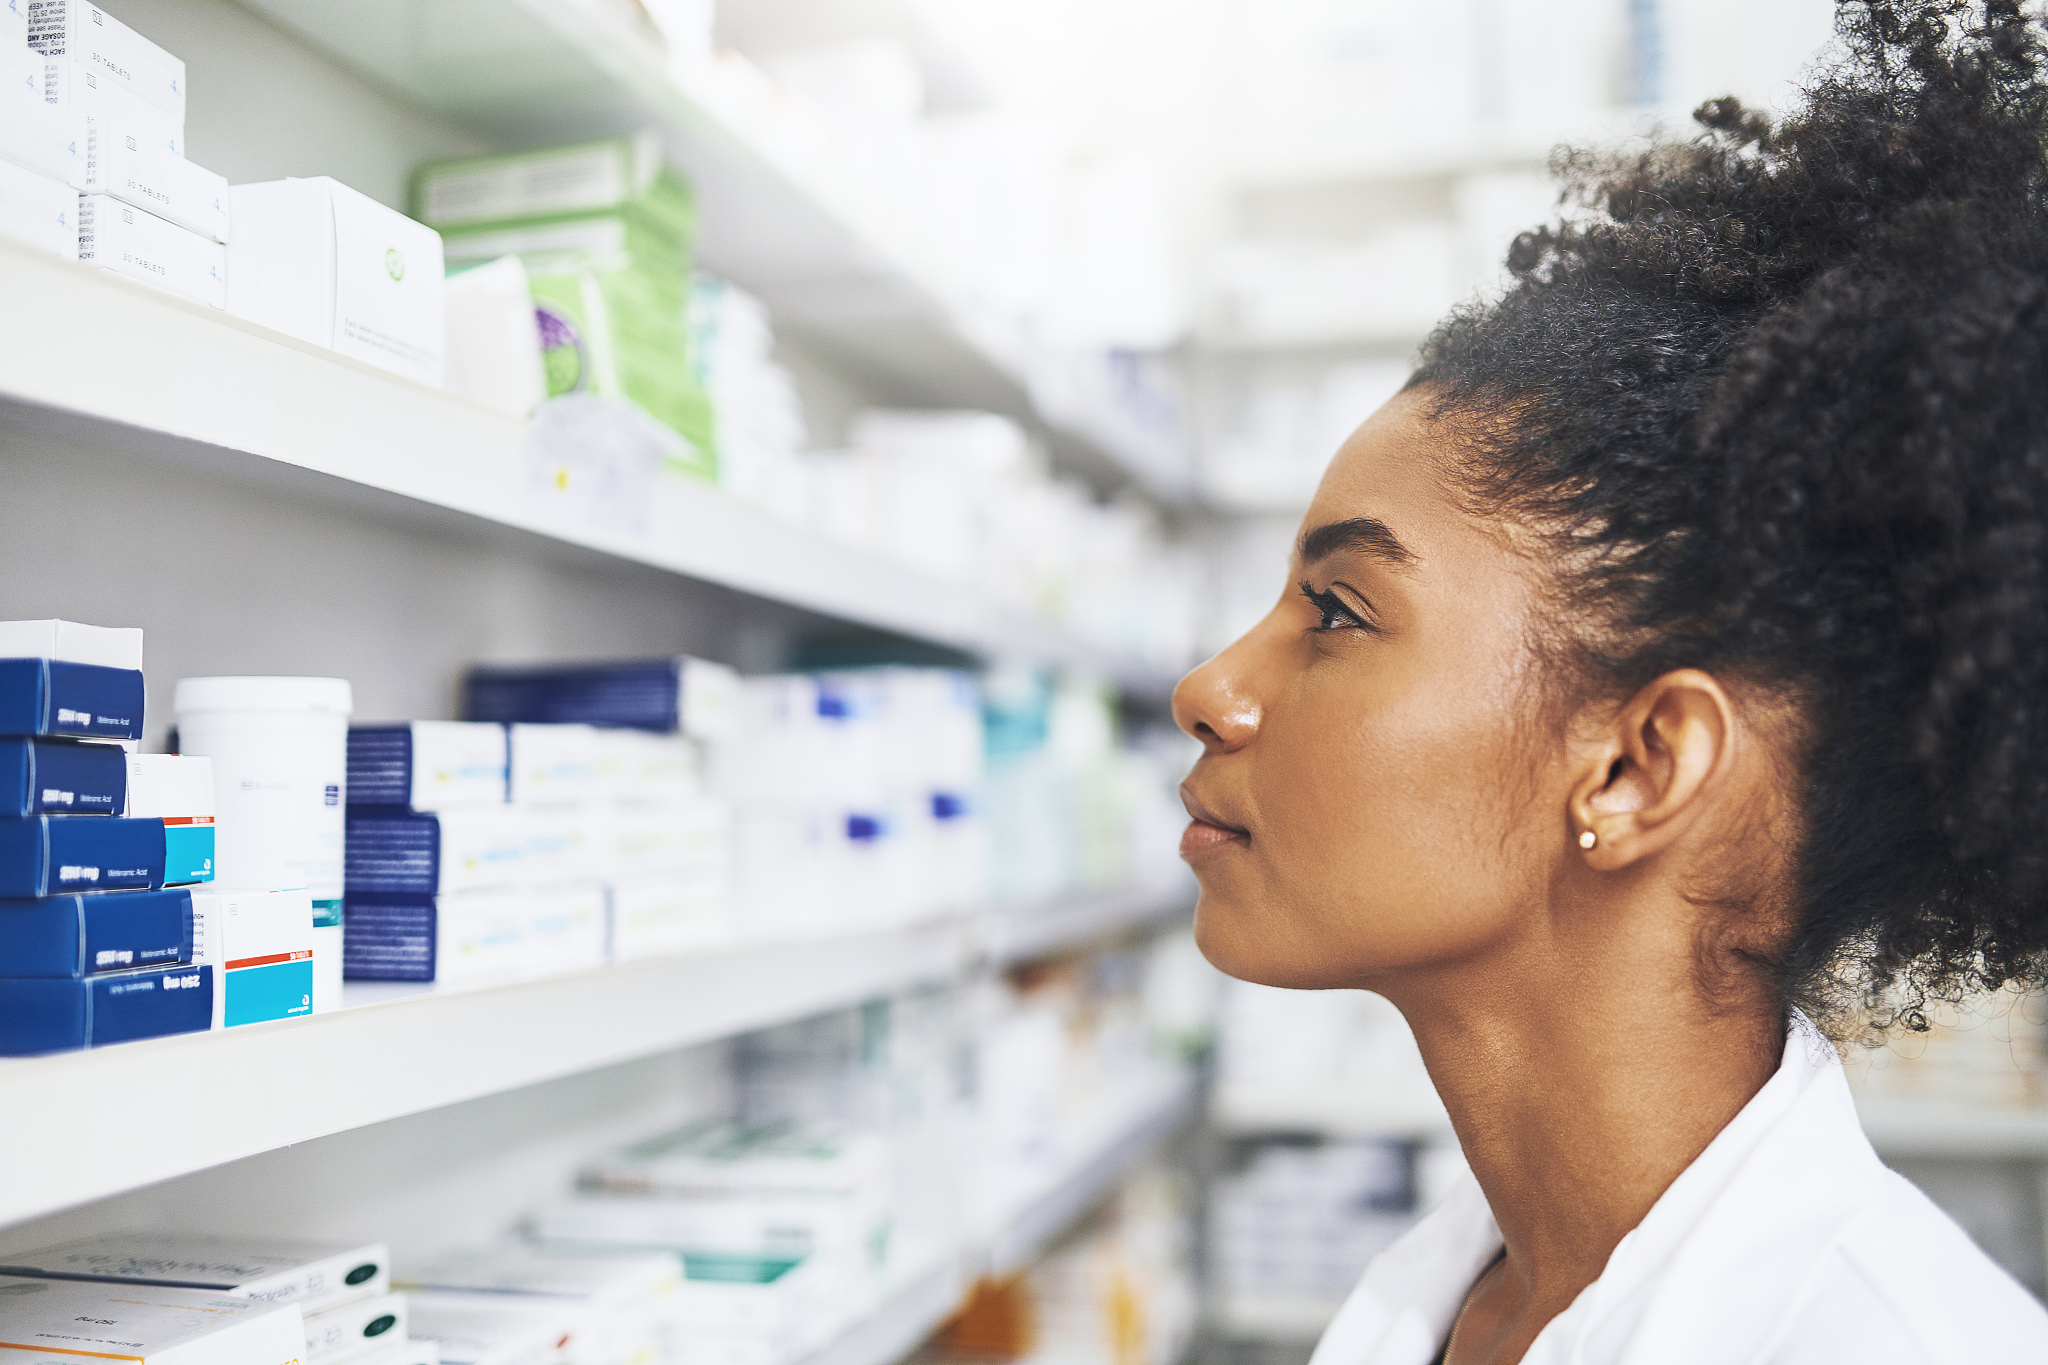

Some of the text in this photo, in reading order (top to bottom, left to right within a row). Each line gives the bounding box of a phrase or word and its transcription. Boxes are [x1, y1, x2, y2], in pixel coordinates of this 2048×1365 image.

[28, 2, 43, 11] KEEP
[41, 32, 66, 41] DOSAGE
[50, 48, 66, 56] EACH
[92, 52, 131, 81] 30 TABLETS
[127, 179, 171, 205] 30 TABLETS
[122, 252, 167, 276] 30 TABLETS
[163, 974, 181, 991] mg
[180, 974, 200, 990] 250
